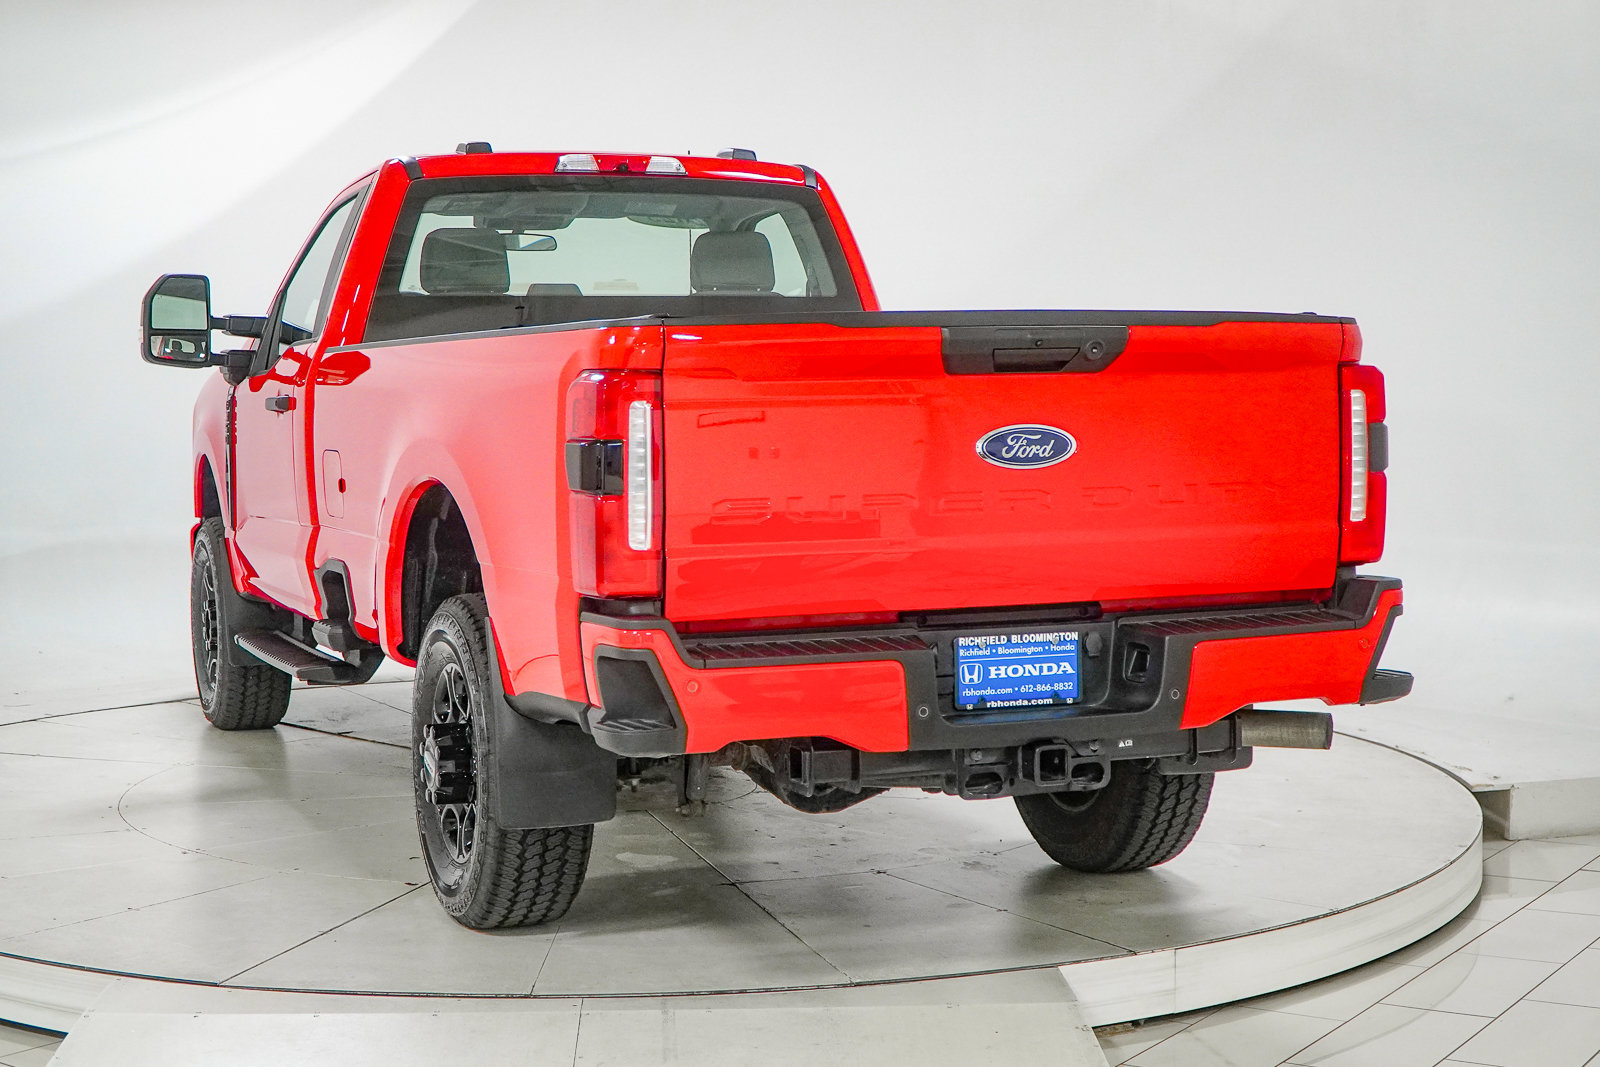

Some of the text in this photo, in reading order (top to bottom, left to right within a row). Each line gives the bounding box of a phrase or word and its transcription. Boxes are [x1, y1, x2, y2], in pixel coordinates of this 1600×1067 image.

[1001, 433, 1055, 459] Ford
[711, 487, 1052, 527] SUPER
[959, 632, 1078, 646] RICHFIELD BLOOMINGTON
[959, 644, 1075, 657] Richfield Bloomington Honda
[988, 662, 1076, 678] HONDA
[962, 682, 1073, 697] rbhonda.com 612-866-8832
[986, 698, 1053, 708] rbhonda.com
